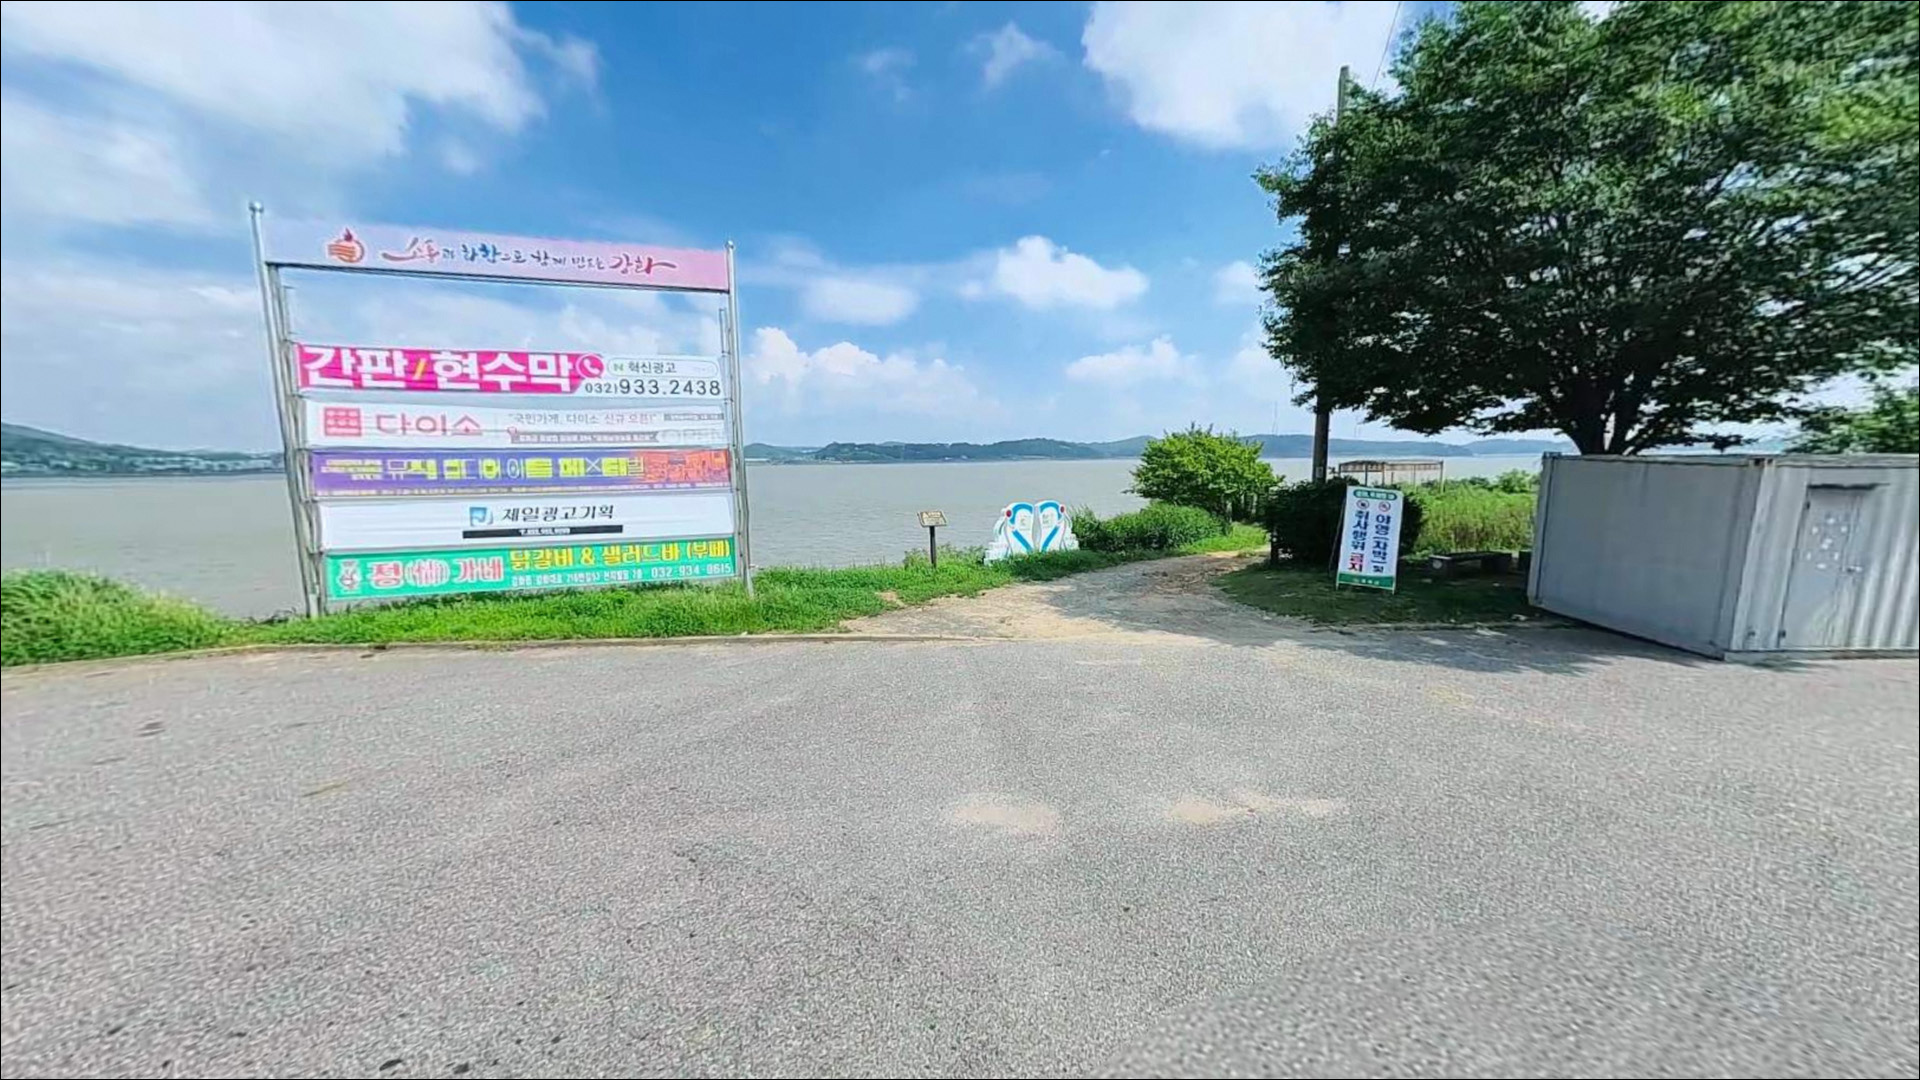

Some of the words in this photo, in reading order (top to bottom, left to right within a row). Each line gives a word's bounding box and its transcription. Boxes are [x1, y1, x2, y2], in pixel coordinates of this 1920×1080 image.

[609, 253, 677, 274] 강화
[628, 361, 678, 375] 혁신광고
[375, 413, 482, 437] 다이소
[501, 504, 615, 523] 제일광고기획
[1351, 510, 1370, 551] 취사행위
[509, 548, 573, 571] 닭갈비
[580, 546, 595, 566] &
[1348, 552, 1365, 573] 금지
